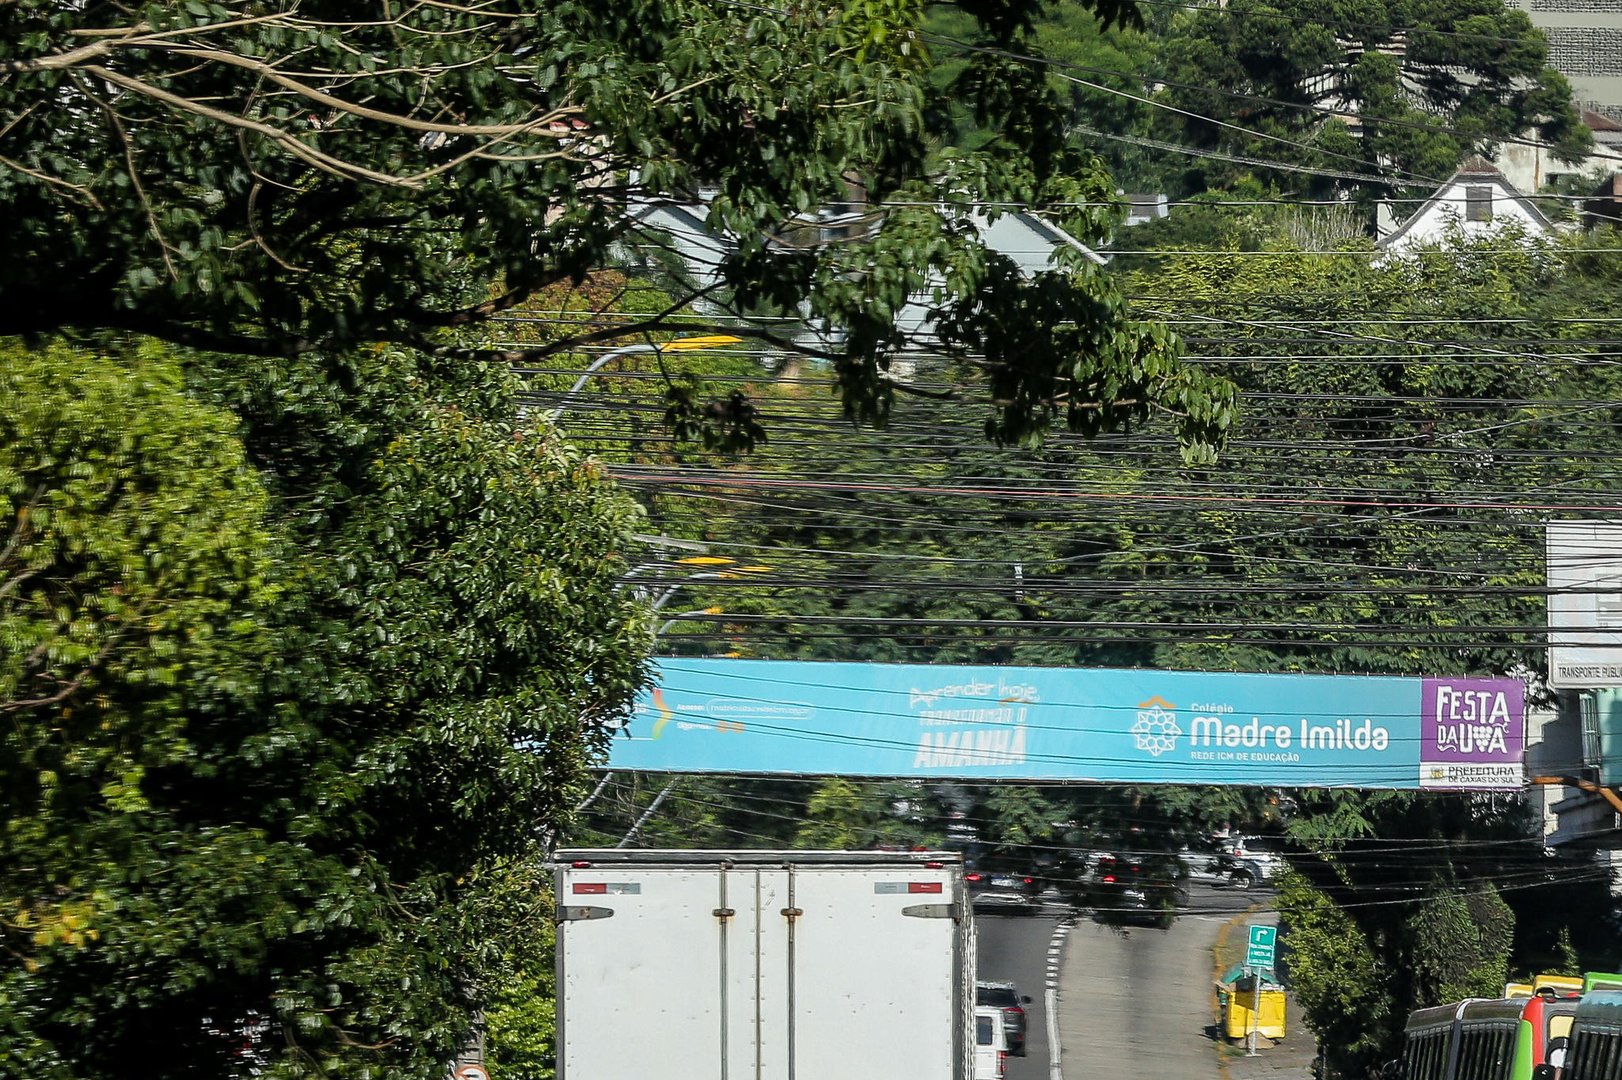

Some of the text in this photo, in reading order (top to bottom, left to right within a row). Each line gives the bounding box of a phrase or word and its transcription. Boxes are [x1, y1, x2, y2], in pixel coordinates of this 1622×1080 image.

[1558, 666, 1600, 678] TRANSPORTE
[1191, 703, 1233, 715] Colégio
[1436, 685, 1511, 724] FESTA
[1190, 716, 1389, 751] Madre Imilda
[1437, 723, 1508, 754] DA UVA
[1190, 751, 1300, 763] REDE ICM DE EDUCAÇÃO
[1448, 766, 1515, 776] PREFEITURA
